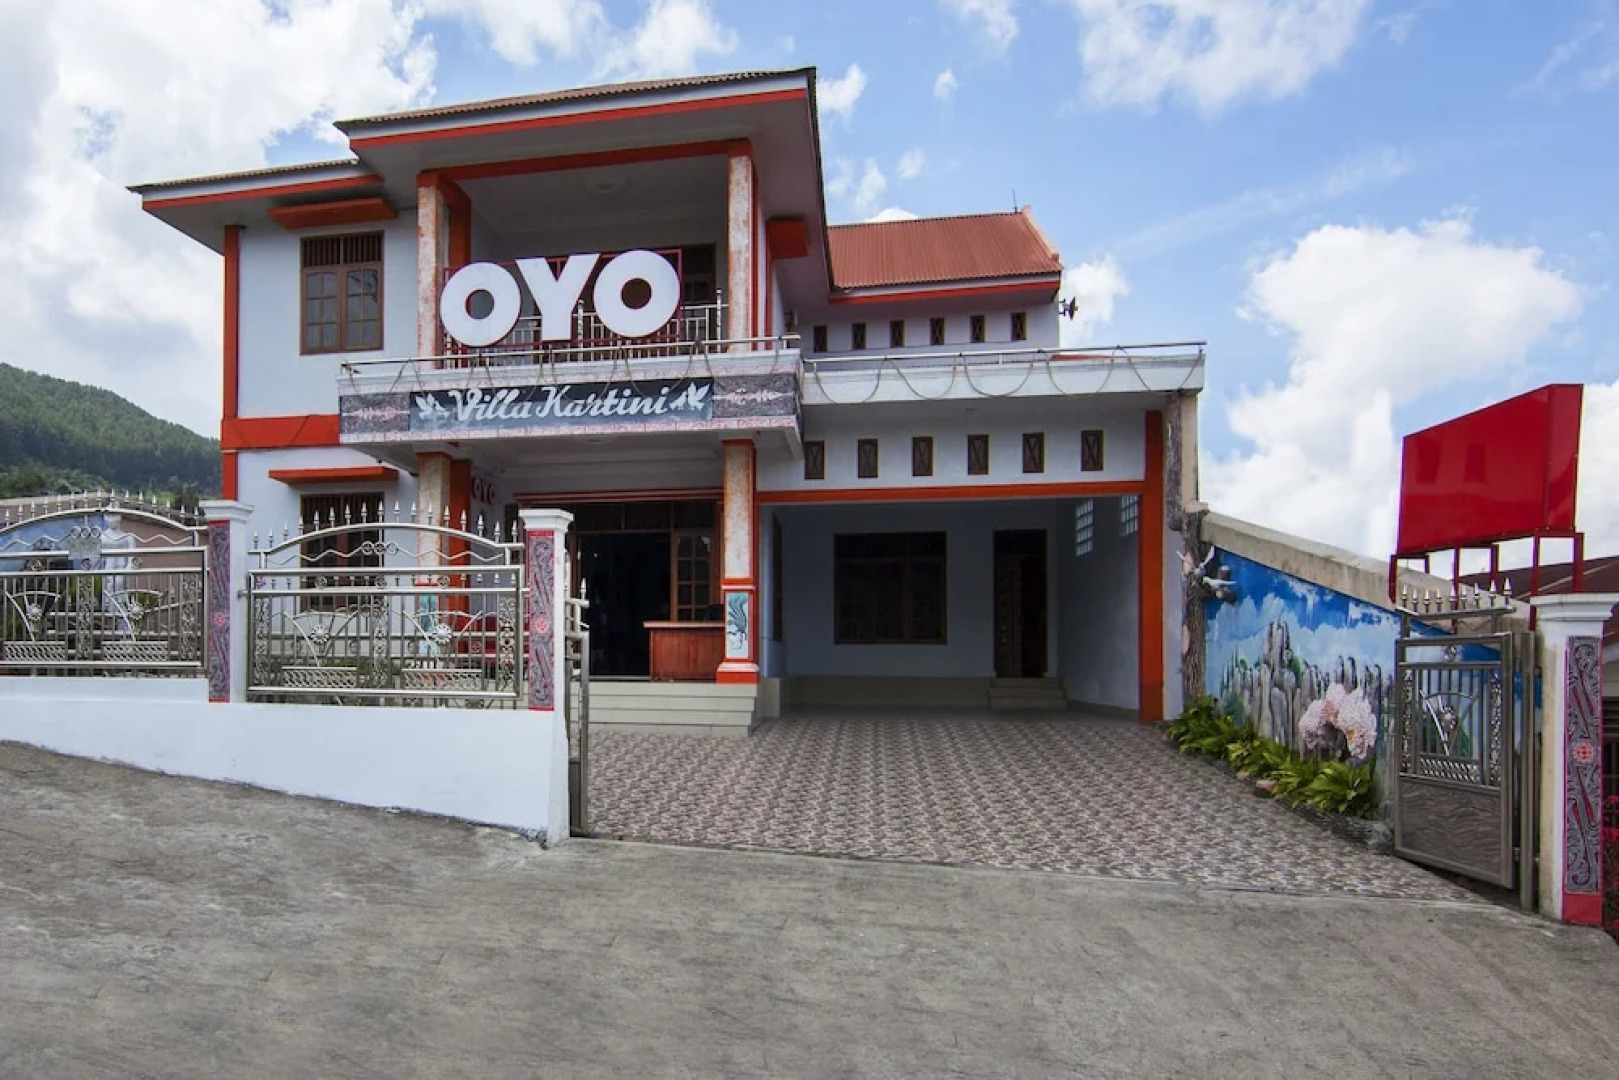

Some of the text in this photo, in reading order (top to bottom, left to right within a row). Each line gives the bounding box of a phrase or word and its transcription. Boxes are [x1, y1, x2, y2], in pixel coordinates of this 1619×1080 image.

[440, 250, 680, 347] OYO
[447, 385, 669, 421] Villa Kartini
[472, 476, 498, 505] OYO
